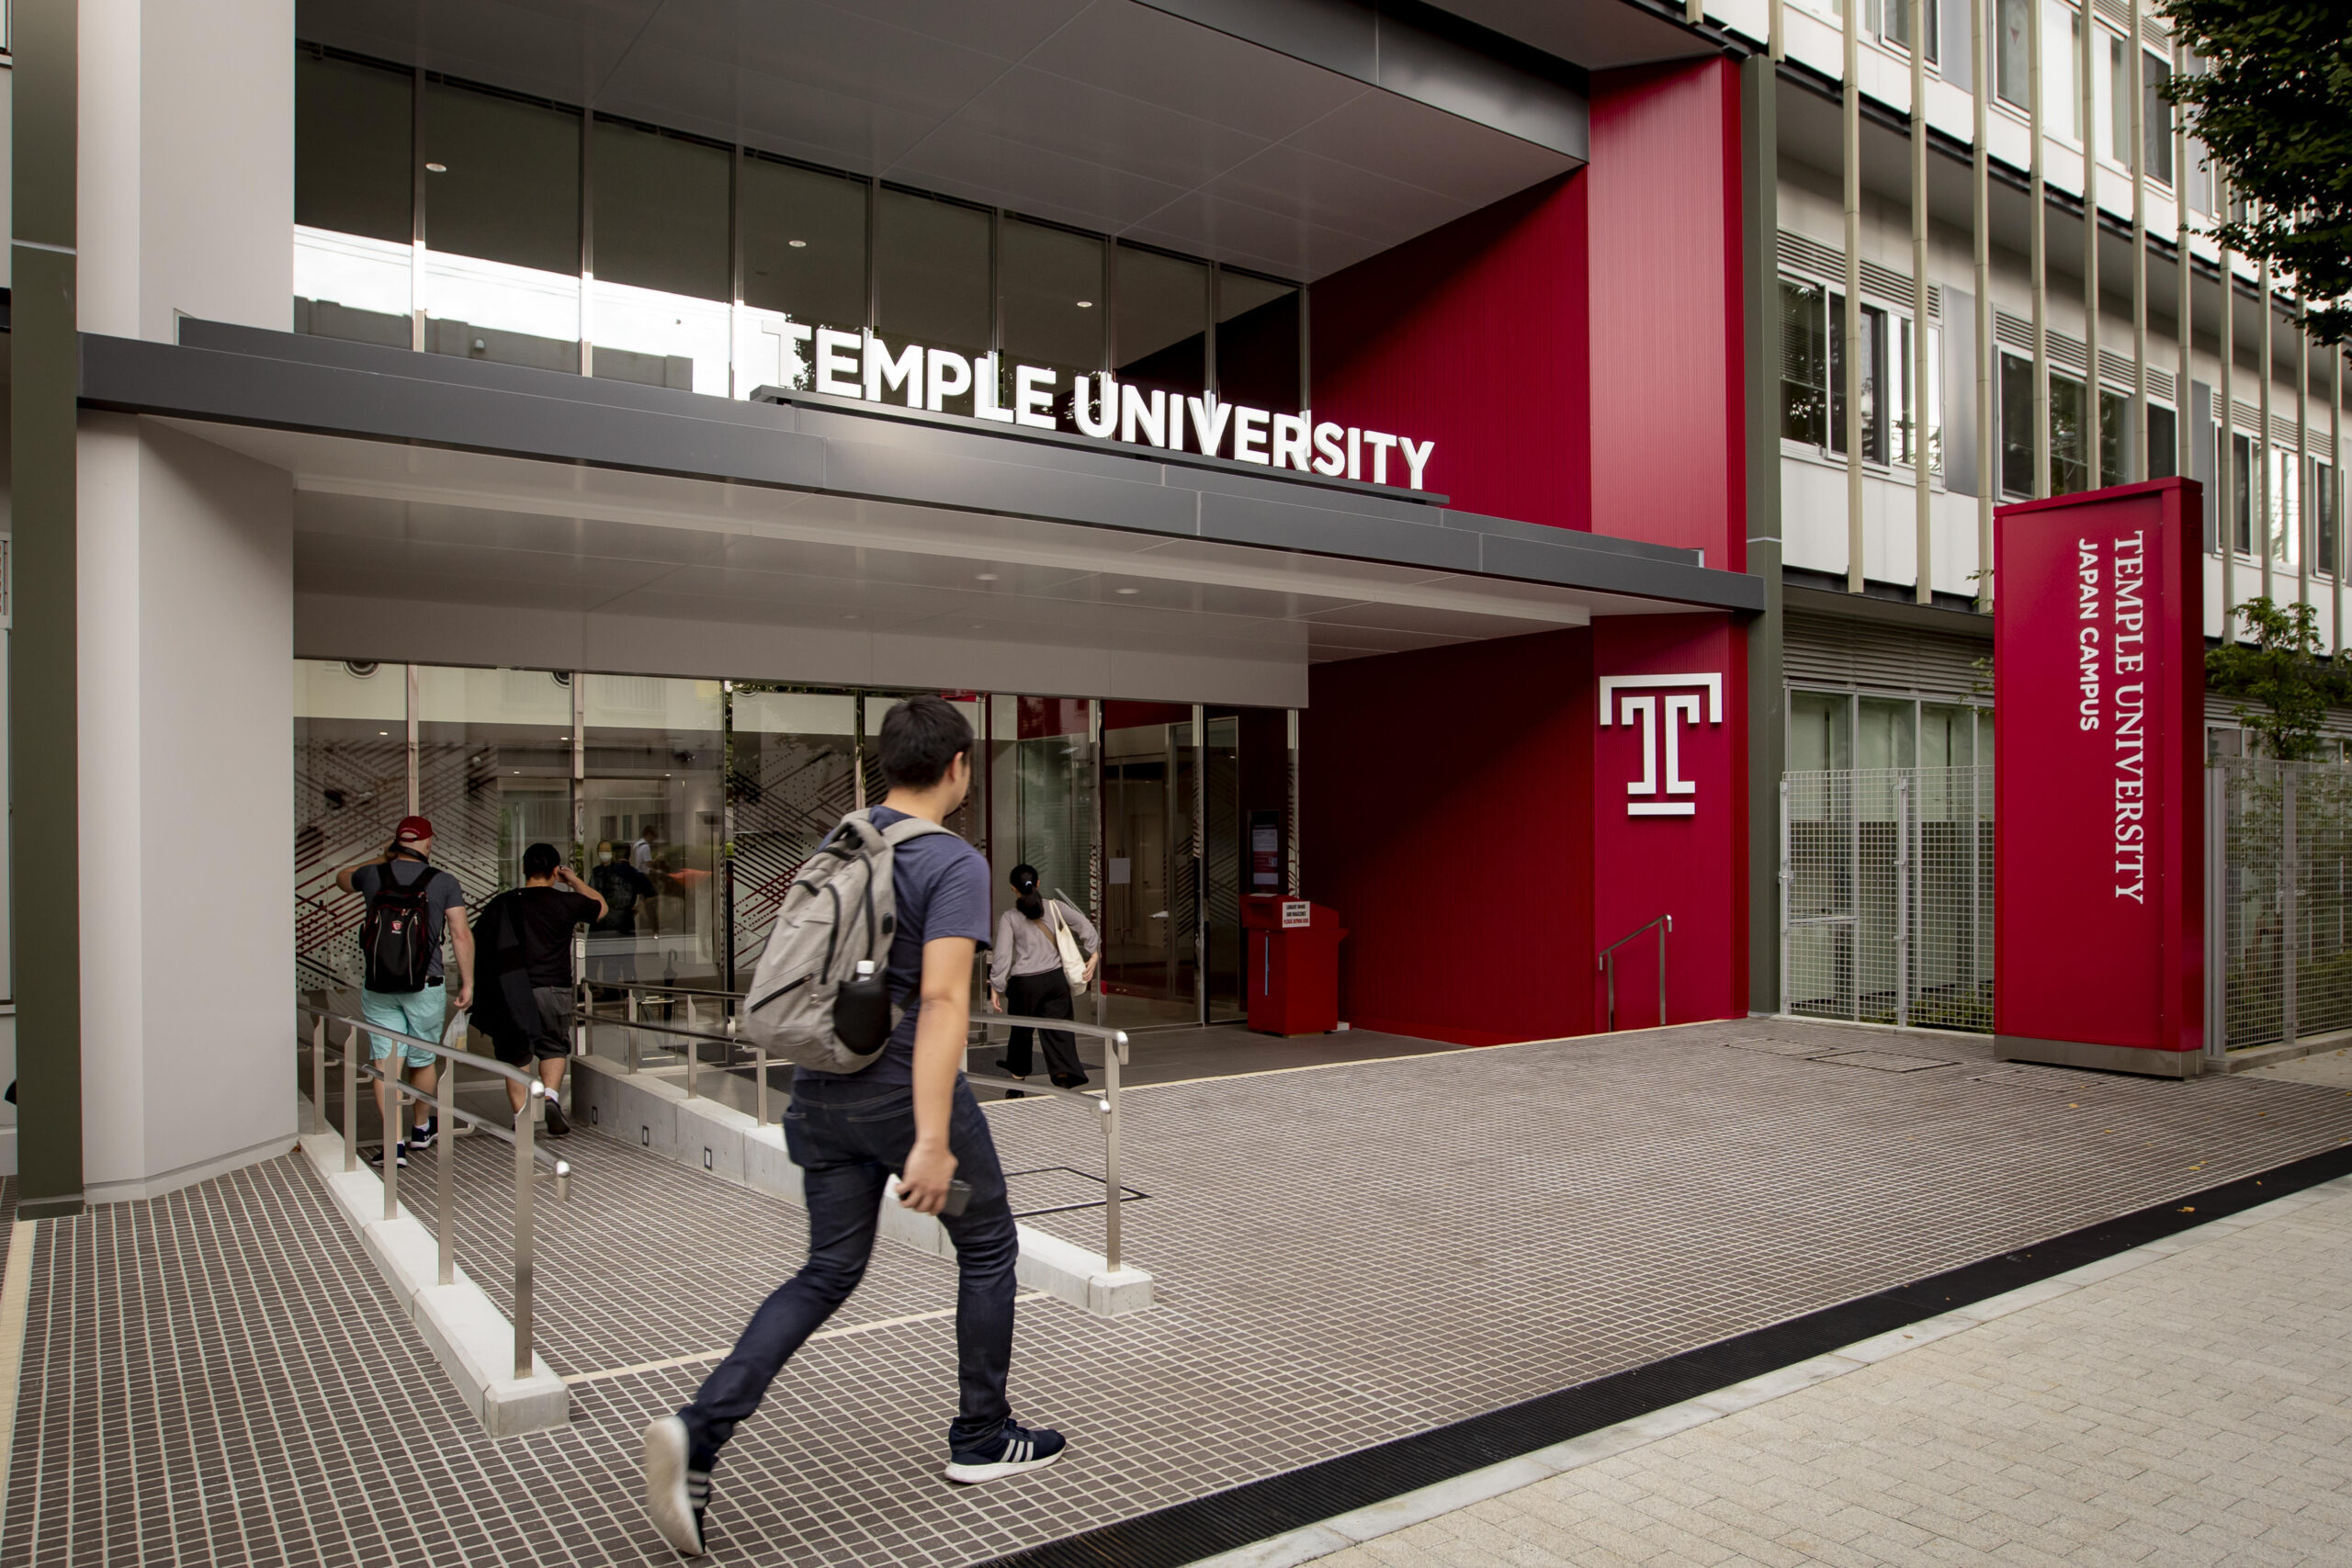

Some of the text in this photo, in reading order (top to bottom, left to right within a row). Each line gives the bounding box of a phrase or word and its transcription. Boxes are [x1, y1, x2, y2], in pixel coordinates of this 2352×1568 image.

[761, 320, 1435, 491] TEMPLE UNIVERSITY
[2077, 537, 2100, 731] JAPAN CAMPUS
[2114, 529, 2144, 905] TEMPLE UNIVERSITY
